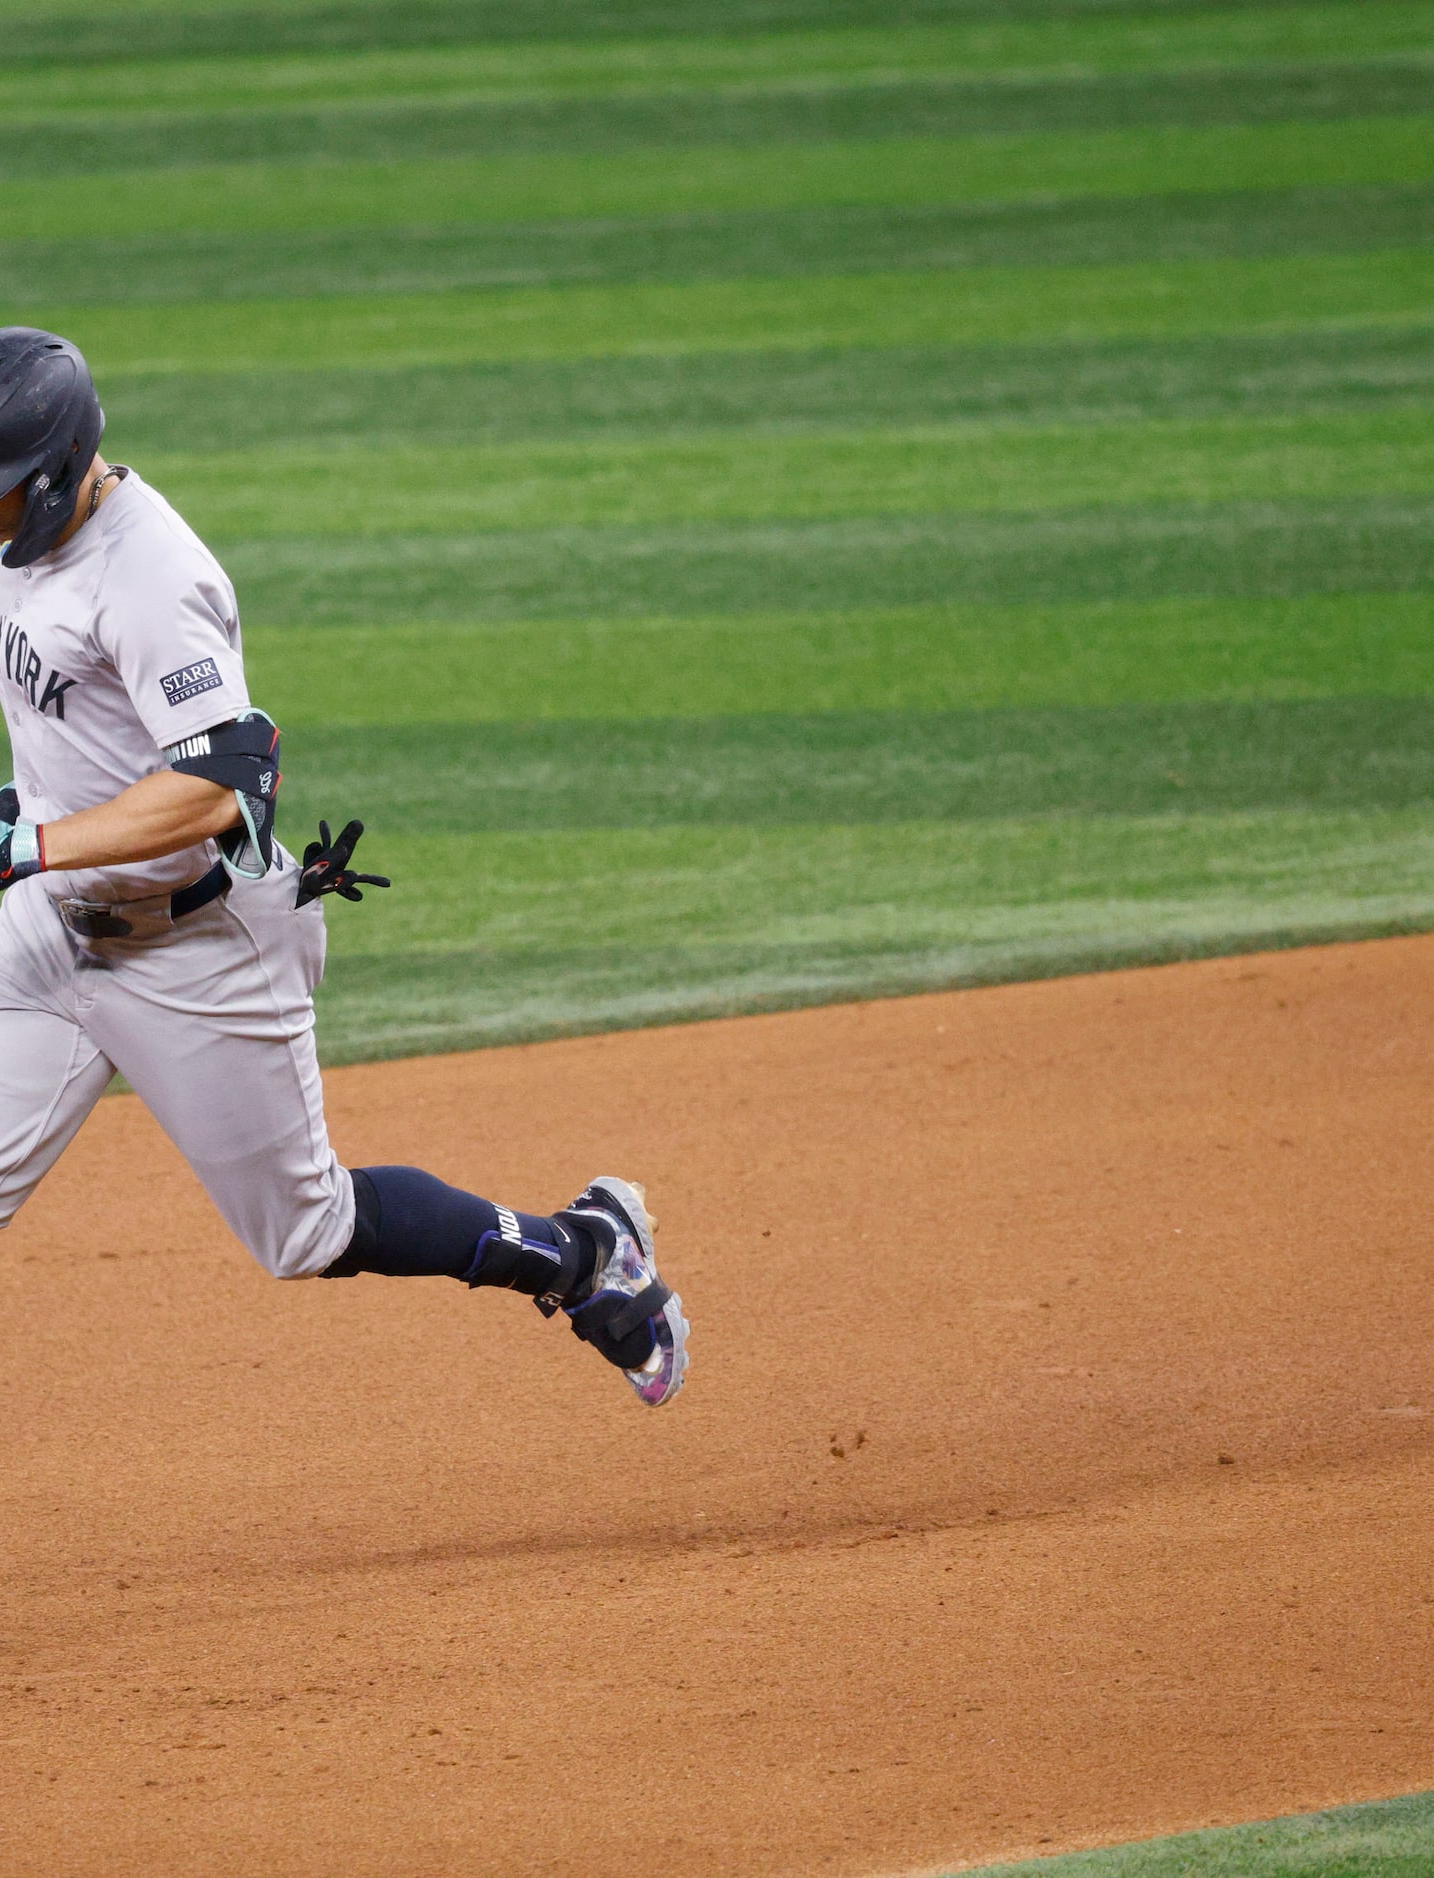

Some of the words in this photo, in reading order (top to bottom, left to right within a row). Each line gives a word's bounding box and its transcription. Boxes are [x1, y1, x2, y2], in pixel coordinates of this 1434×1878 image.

[5, 621, 78, 720] YORK
[163, 661, 217, 693] STARR
[170, 678, 220, 704] INSURANCE
